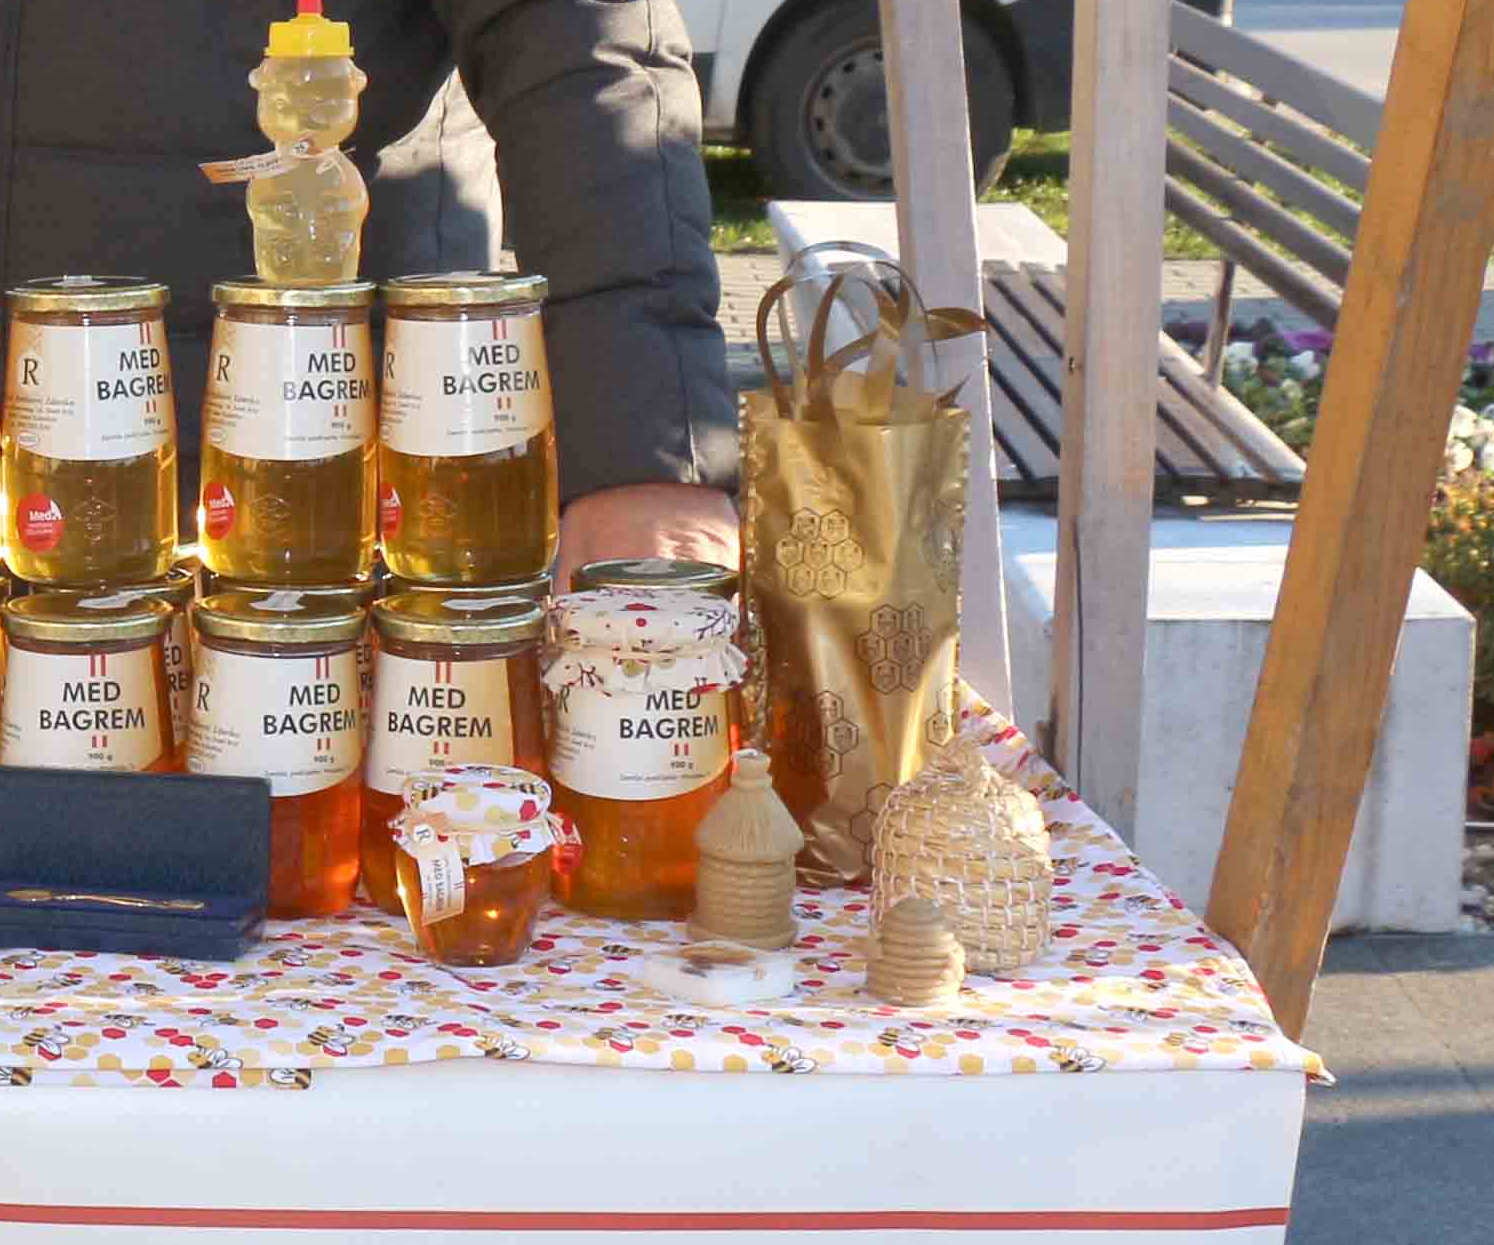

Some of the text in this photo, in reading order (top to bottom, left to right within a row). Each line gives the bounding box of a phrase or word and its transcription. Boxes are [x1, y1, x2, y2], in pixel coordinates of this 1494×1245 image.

[119, 348, 160, 372] MED
[308, 353, 356, 374] MED
[468, 344, 520, 366] MED
[21, 358, 39, 386] R
[216, 354, 231, 382] R
[284, 379, 369, 401] BAGREM
[443, 370, 540, 395] BAGREM
[62, 681, 121, 703] MED
[196, 682, 211, 712] R
[289, 683, 340, 706] MED
[408, 685, 466, 709] MED
[645, 689, 702, 711] MED
[39, 707, 145, 731] BAGREM
[263, 709, 356, 735] BAGREM
[387, 711, 492, 738] BAGREM
[619, 714, 719, 739] BAGREM
